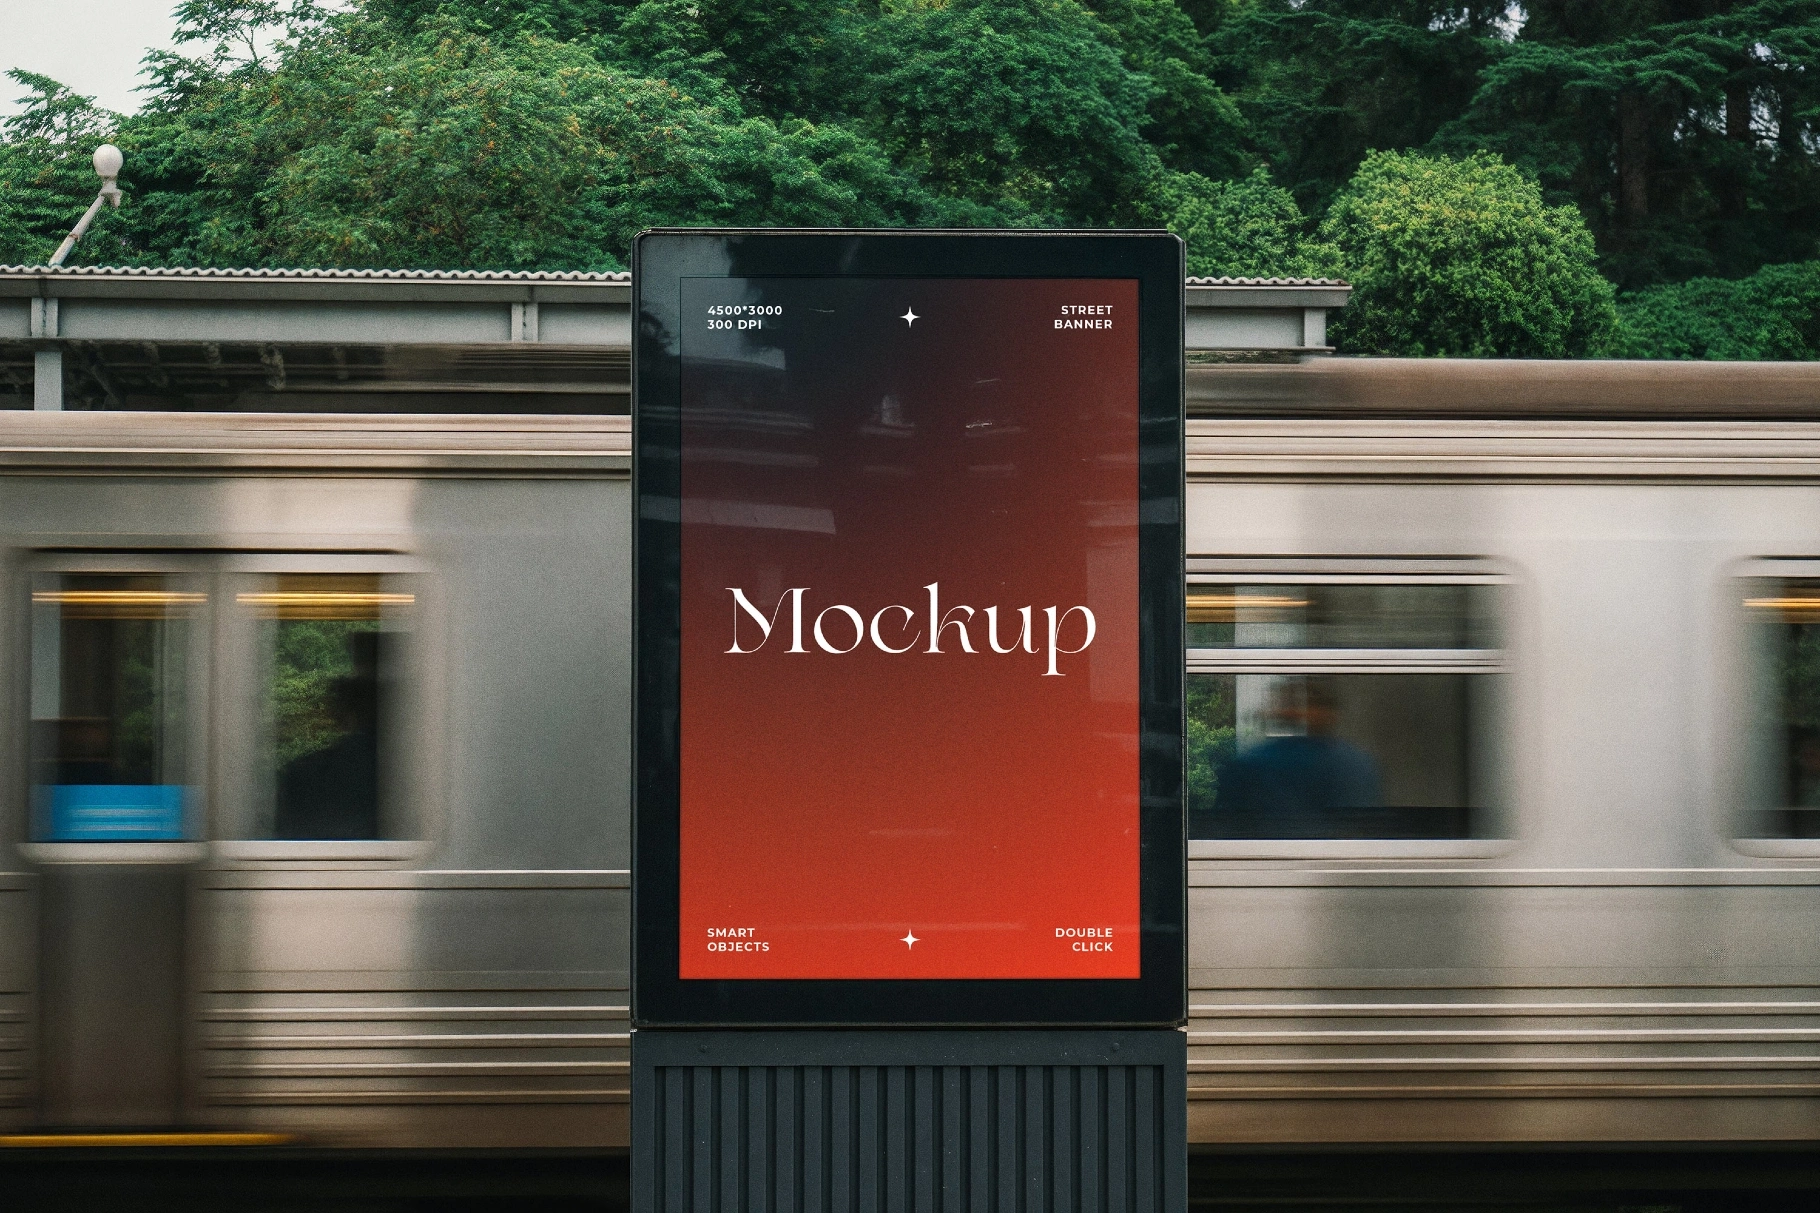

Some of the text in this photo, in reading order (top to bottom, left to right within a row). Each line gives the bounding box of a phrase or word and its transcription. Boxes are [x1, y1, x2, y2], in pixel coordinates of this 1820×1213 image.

[1061, 305, 1113, 315] STREET
[707, 319, 762, 330] 300 DPI
[1054, 319, 1113, 329] BANNER
[724, 581, 1097, 677] Mockup
[707, 927, 756, 938] SMART
[1055, 927, 1113, 938] DOUBLE
[707, 941, 770, 952] OBJECTS
[1072, 941, 1113, 952] CLICK
